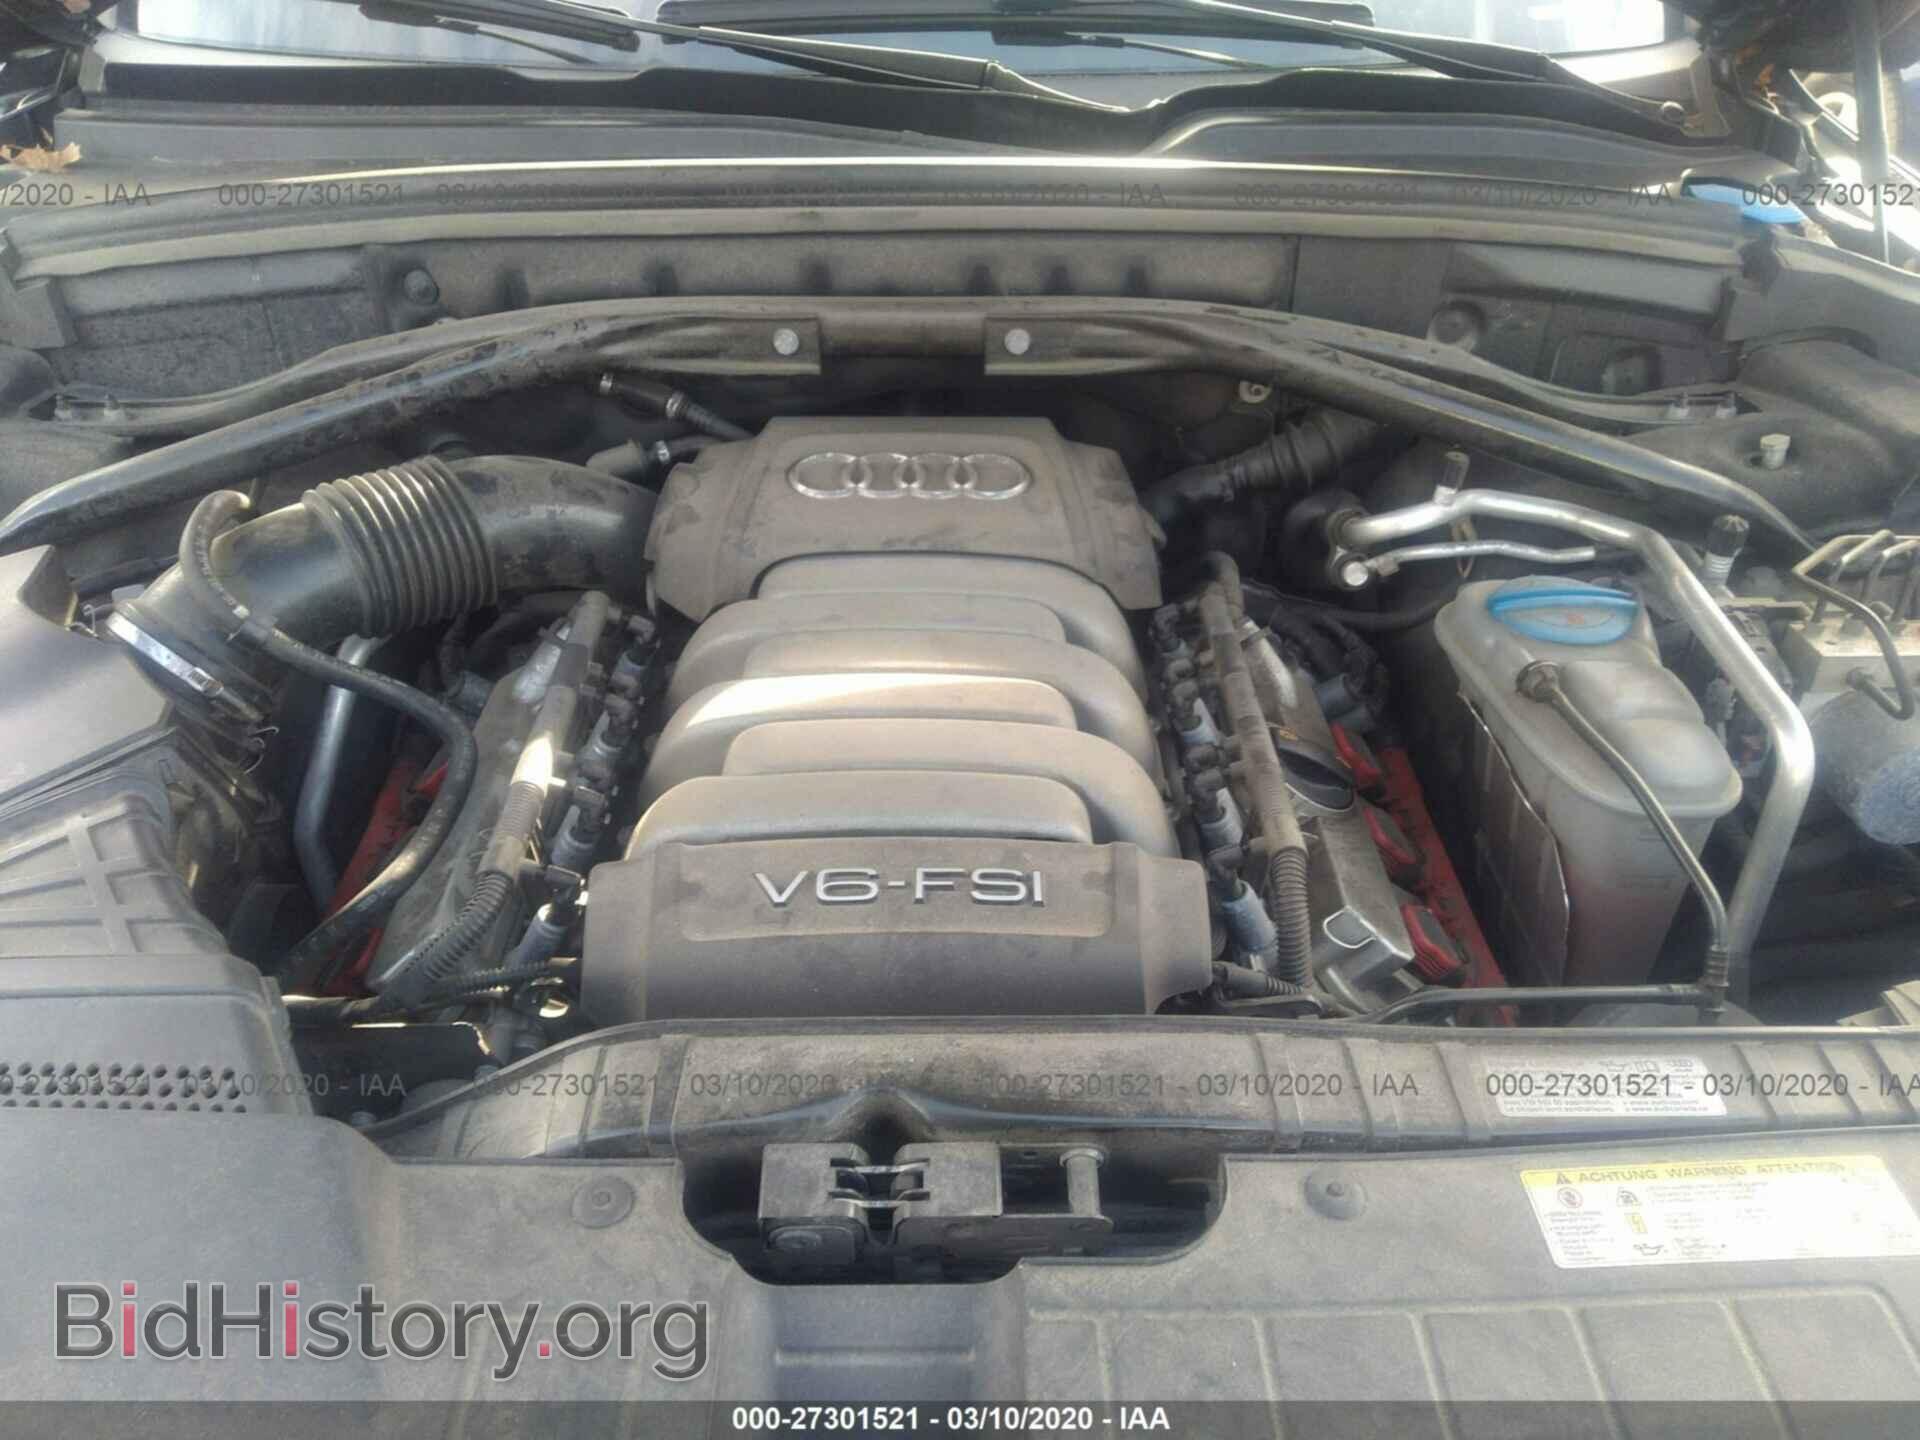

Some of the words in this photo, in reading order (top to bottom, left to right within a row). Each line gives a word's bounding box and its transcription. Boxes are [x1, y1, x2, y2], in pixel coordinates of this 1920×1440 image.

[753, 867, 1044, 906] V6-FSI
[1578, 1168, 1658, 1184] ACHTUNG
[1665, 1164, 1747, 1179] WARNING
